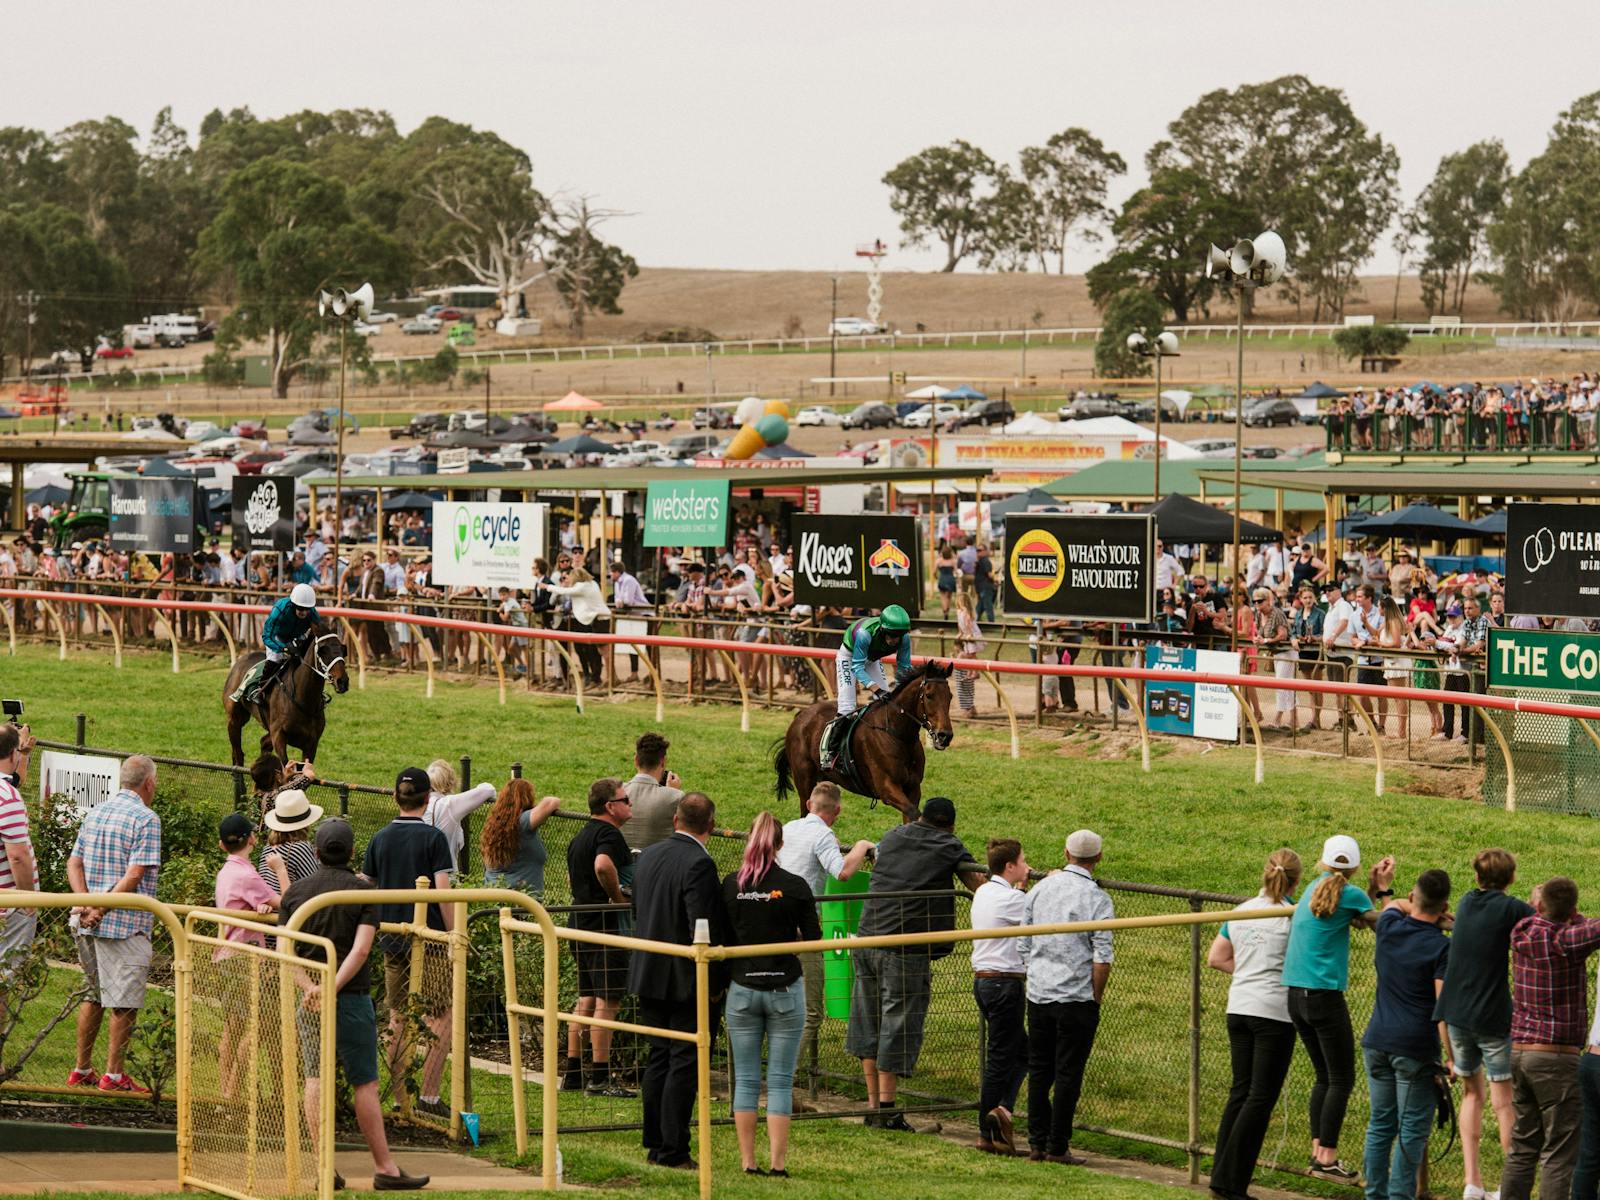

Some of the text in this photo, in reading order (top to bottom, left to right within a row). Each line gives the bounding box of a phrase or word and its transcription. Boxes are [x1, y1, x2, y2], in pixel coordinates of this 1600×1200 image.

[111, 493, 147, 515] Harcourts
[652, 488, 720, 521] websters
[473, 506, 521, 549] ecycle
[797, 532, 854, 587] Klose's
[1018, 557, 1057, 574] MELBA'S
[1068, 539, 1140, 566] WHAT'S YOUR
[821, 579, 858, 590] SUPERMARKETS
[1496, 637, 1600, 680] THE CO
